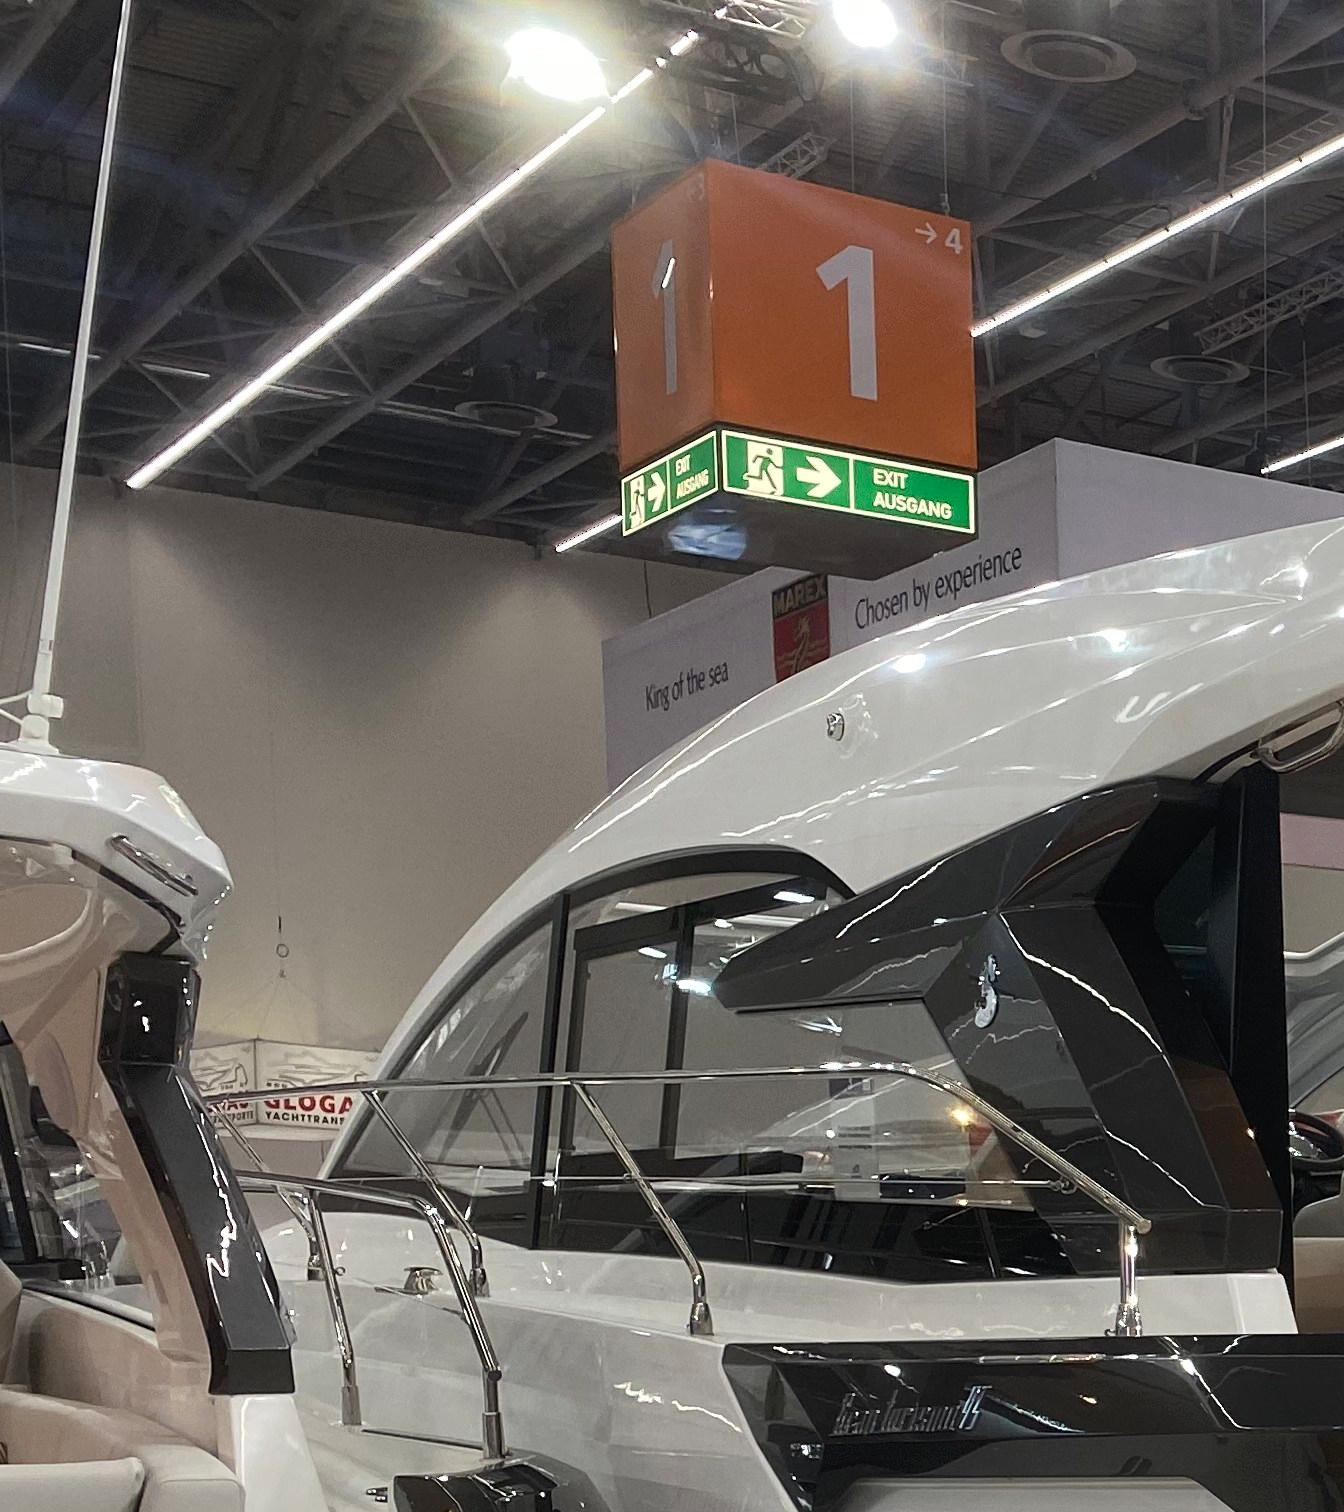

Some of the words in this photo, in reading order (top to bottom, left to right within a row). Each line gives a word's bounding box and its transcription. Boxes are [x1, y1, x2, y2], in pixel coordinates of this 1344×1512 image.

[944, 228, 963, 255] 4
[653, 239, 678, 395] 1
[815, 244, 878, 401] 1
[675, 454, 691, 477] EXIT
[873, 468, 909, 490] EXIT
[675, 469, 710, 499] AUSGANG
[873, 491, 952, 520] AUSGANG
[855, 589, 909, 629] Chosen
[912, 578, 931, 612] by
[934, 545, 1022, 601] experience
[646, 682, 670, 712] King
[671, 673, 686, 698] of
[686, 665, 705, 693] the
[707, 661, 729, 686] sea
